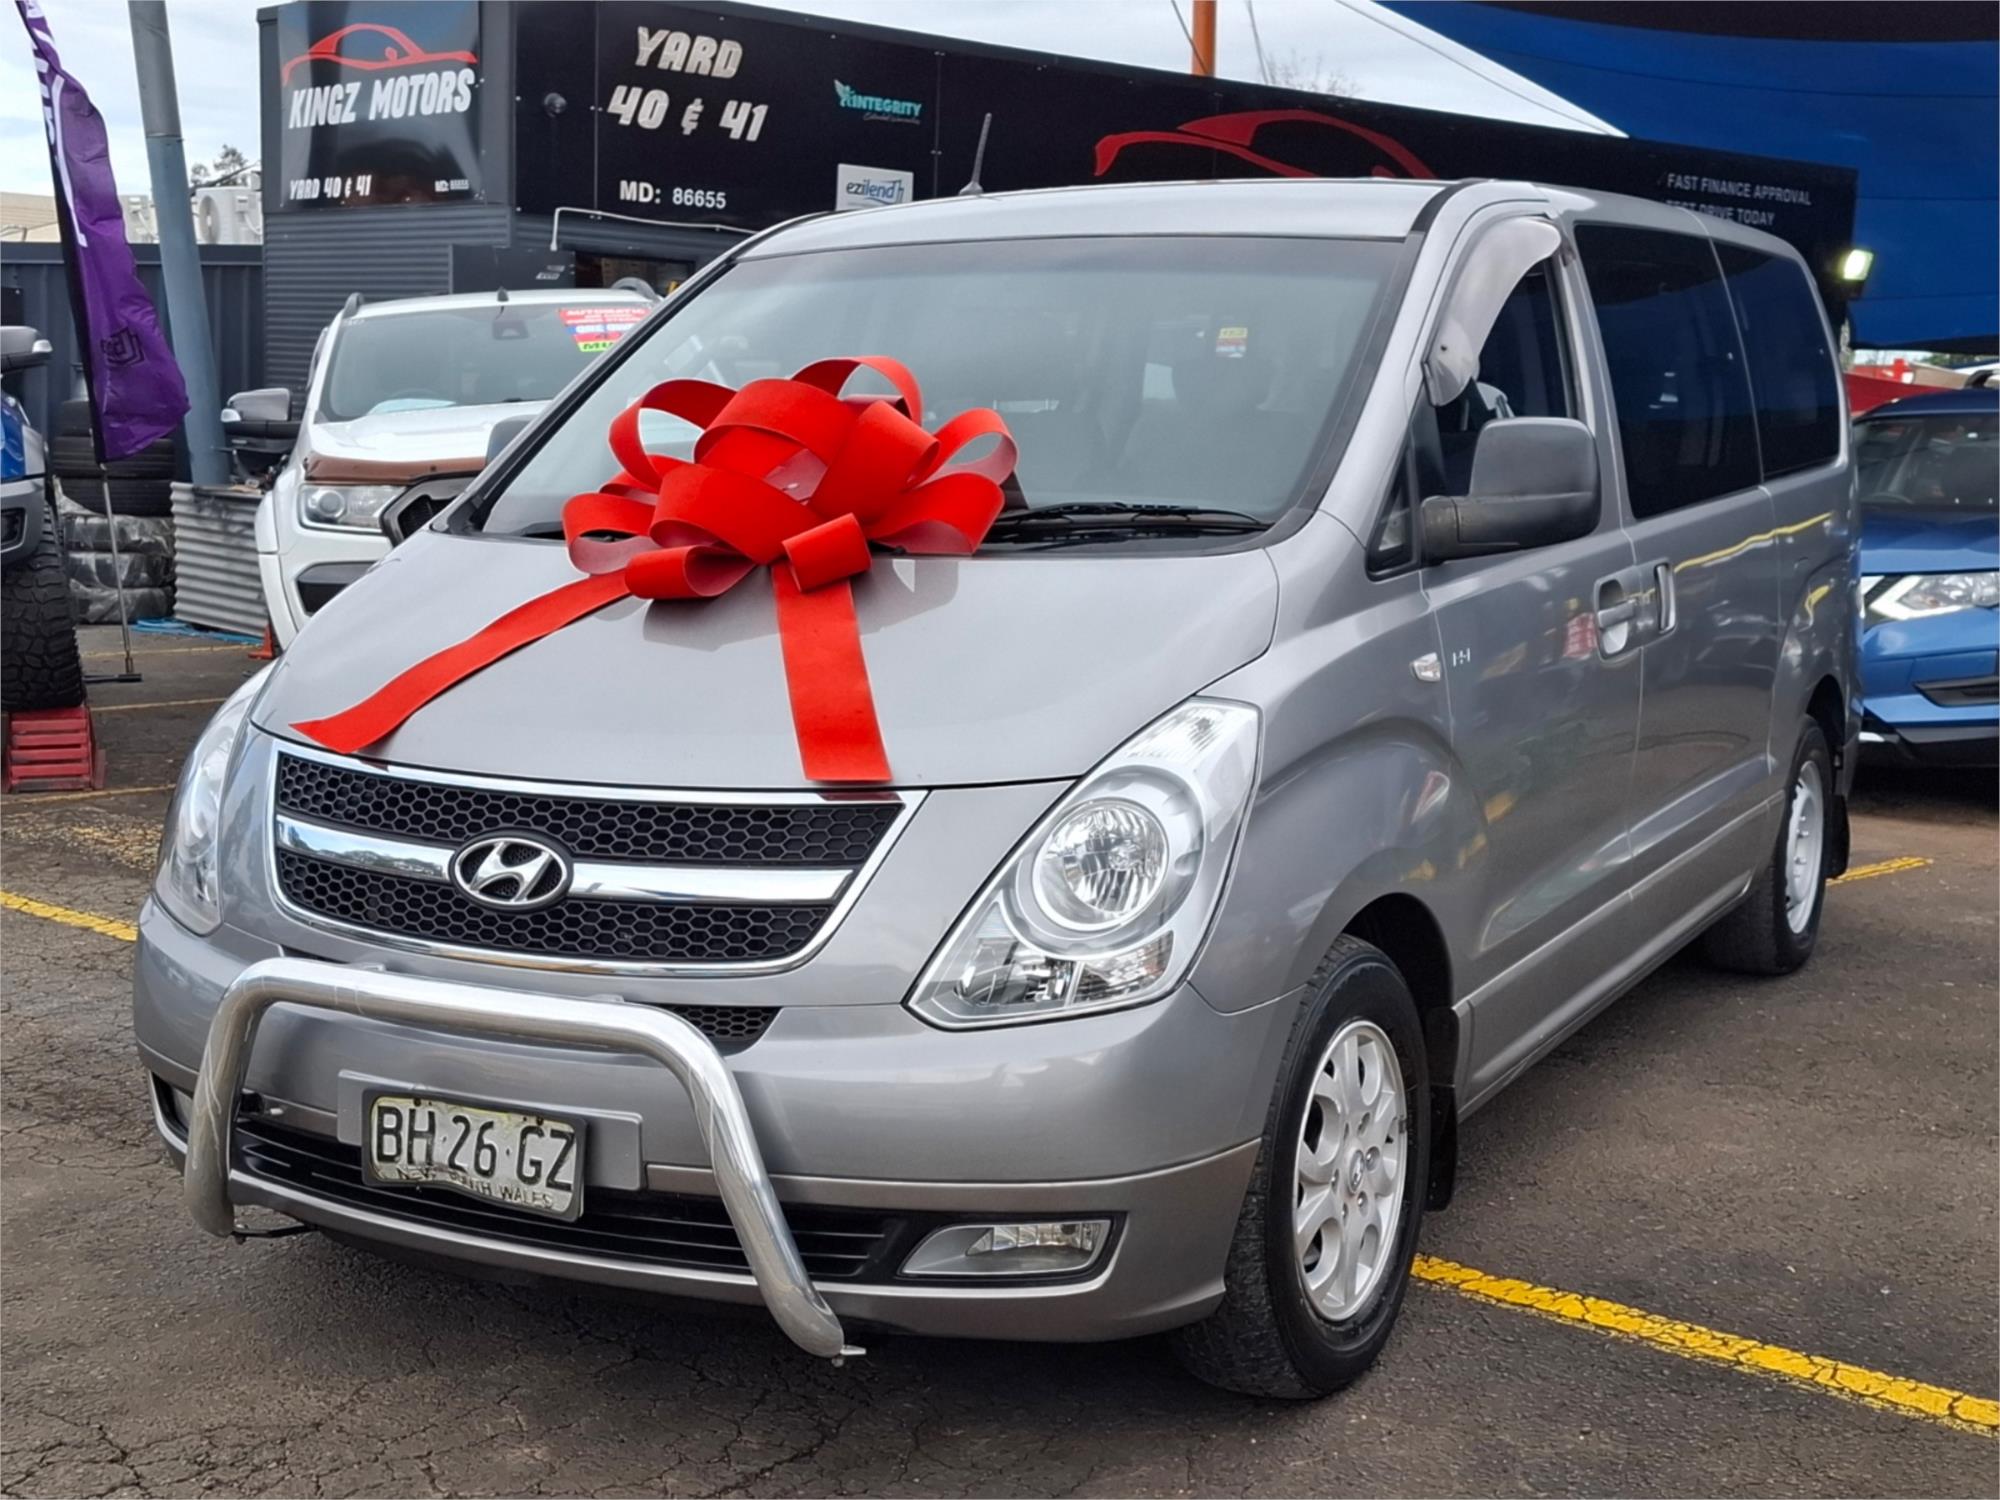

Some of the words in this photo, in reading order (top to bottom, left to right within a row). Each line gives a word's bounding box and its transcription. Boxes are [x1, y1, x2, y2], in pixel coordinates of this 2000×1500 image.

[635, 26, 743, 79] YARD
[288, 81, 361, 129] KINGZ
[368, 68, 475, 120] MOTORS
[606, 84, 669, 130] 40
[681, 97, 704, 135] &
[718, 99, 769, 142] 41
[290, 178, 320, 200] YARD
[323, 176, 342, 198] 40
[356, 174, 373, 196] 41
[619, 179, 661, 204] MD:
[672, 187, 727, 209] 86655
[1667, 173, 1699, 191] FAST
[1700, 177, 1752, 198] FINANCE
[1753, 184, 1812, 206] APPROVAL
[1737, 207, 1776, 226] TODAY
[500, 1184, 554, 1209] WALES
